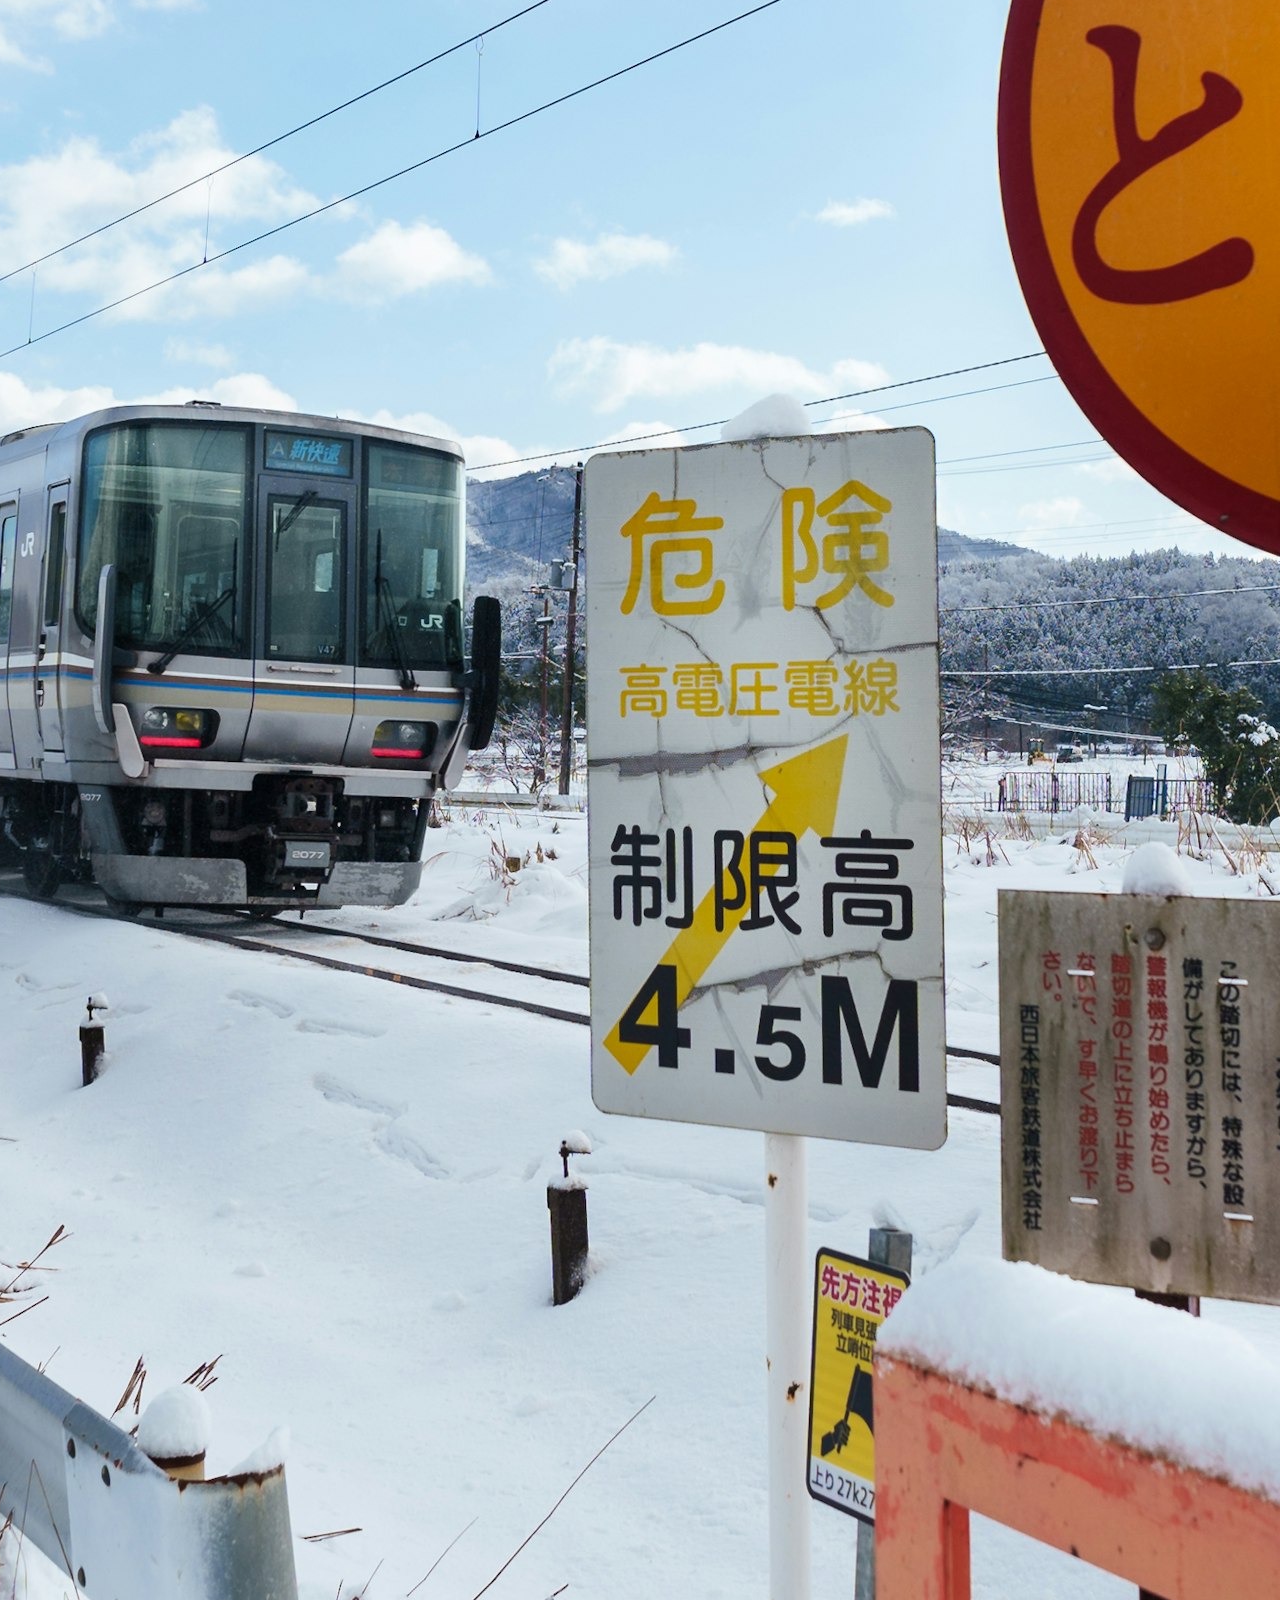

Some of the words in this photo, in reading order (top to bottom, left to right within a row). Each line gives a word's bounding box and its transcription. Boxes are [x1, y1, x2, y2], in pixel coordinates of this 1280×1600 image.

[289, 439, 343, 465] 新快速
[21, 532, 35, 557] JR
[620, 479, 896, 616] 危険
[420, 614, 443, 629] JR
[619, 657, 901, 718] 高電圧電線
[292, 851, 325, 860] 2077
[610, 824, 915, 942] 制限高
[619, 964, 921, 1093] 4.5M
[1021, 1004, 1042, 1231] 西日本旅客鉄道株式会社
[811, 1464, 834, 1491] 上り
